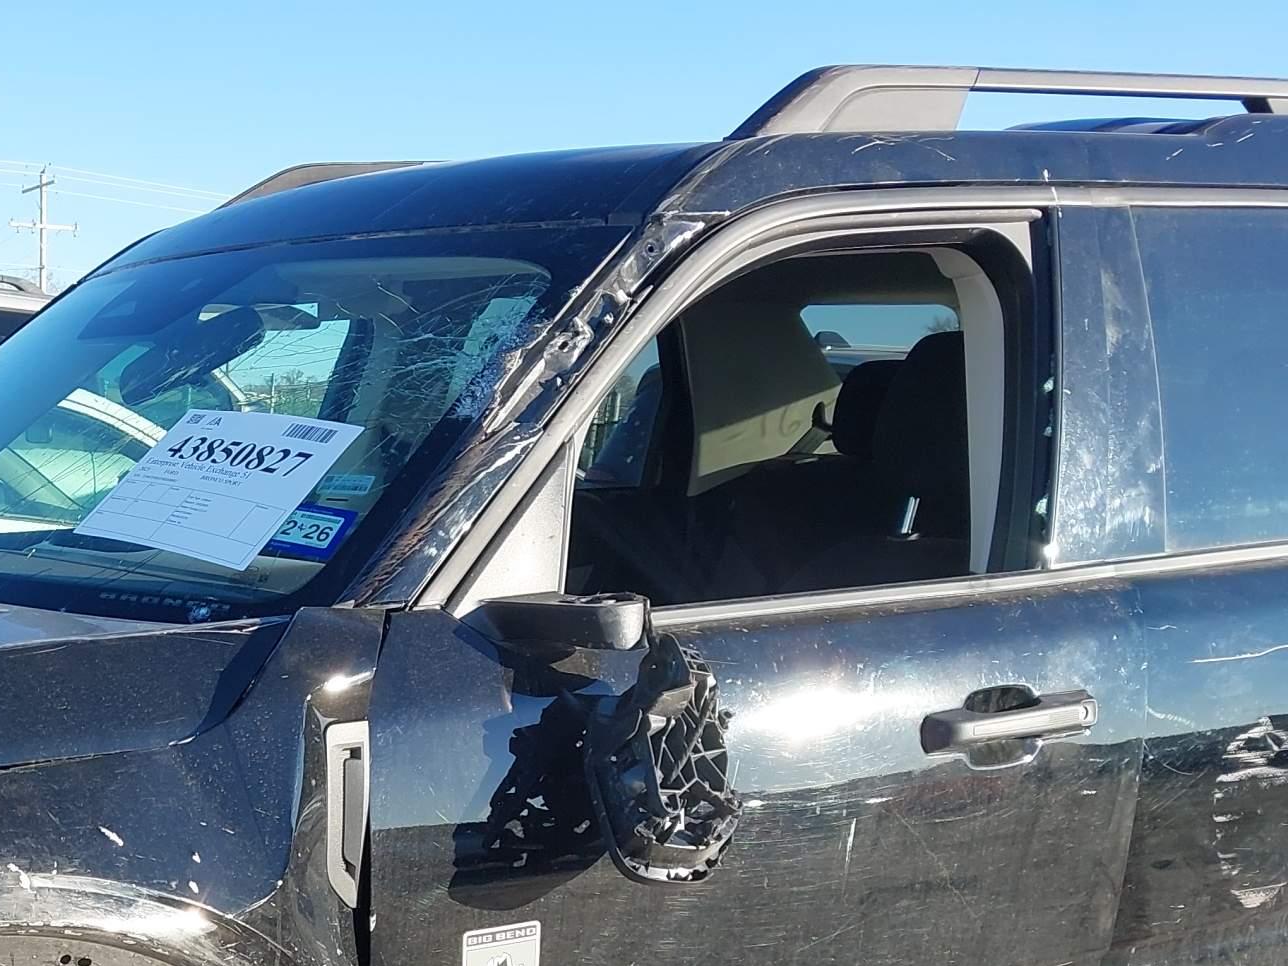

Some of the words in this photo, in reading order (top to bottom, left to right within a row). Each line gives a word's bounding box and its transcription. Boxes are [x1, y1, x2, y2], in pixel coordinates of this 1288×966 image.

[167, 435, 315, 477] 43850827
[146, 457, 180, 468] Enterprise
[180, 460, 205, 471] Vehicle
[205, 465, 240, 479] Exchange
[467, 934, 493, 946] BIG
[495, 927, 537, 941] BEND
